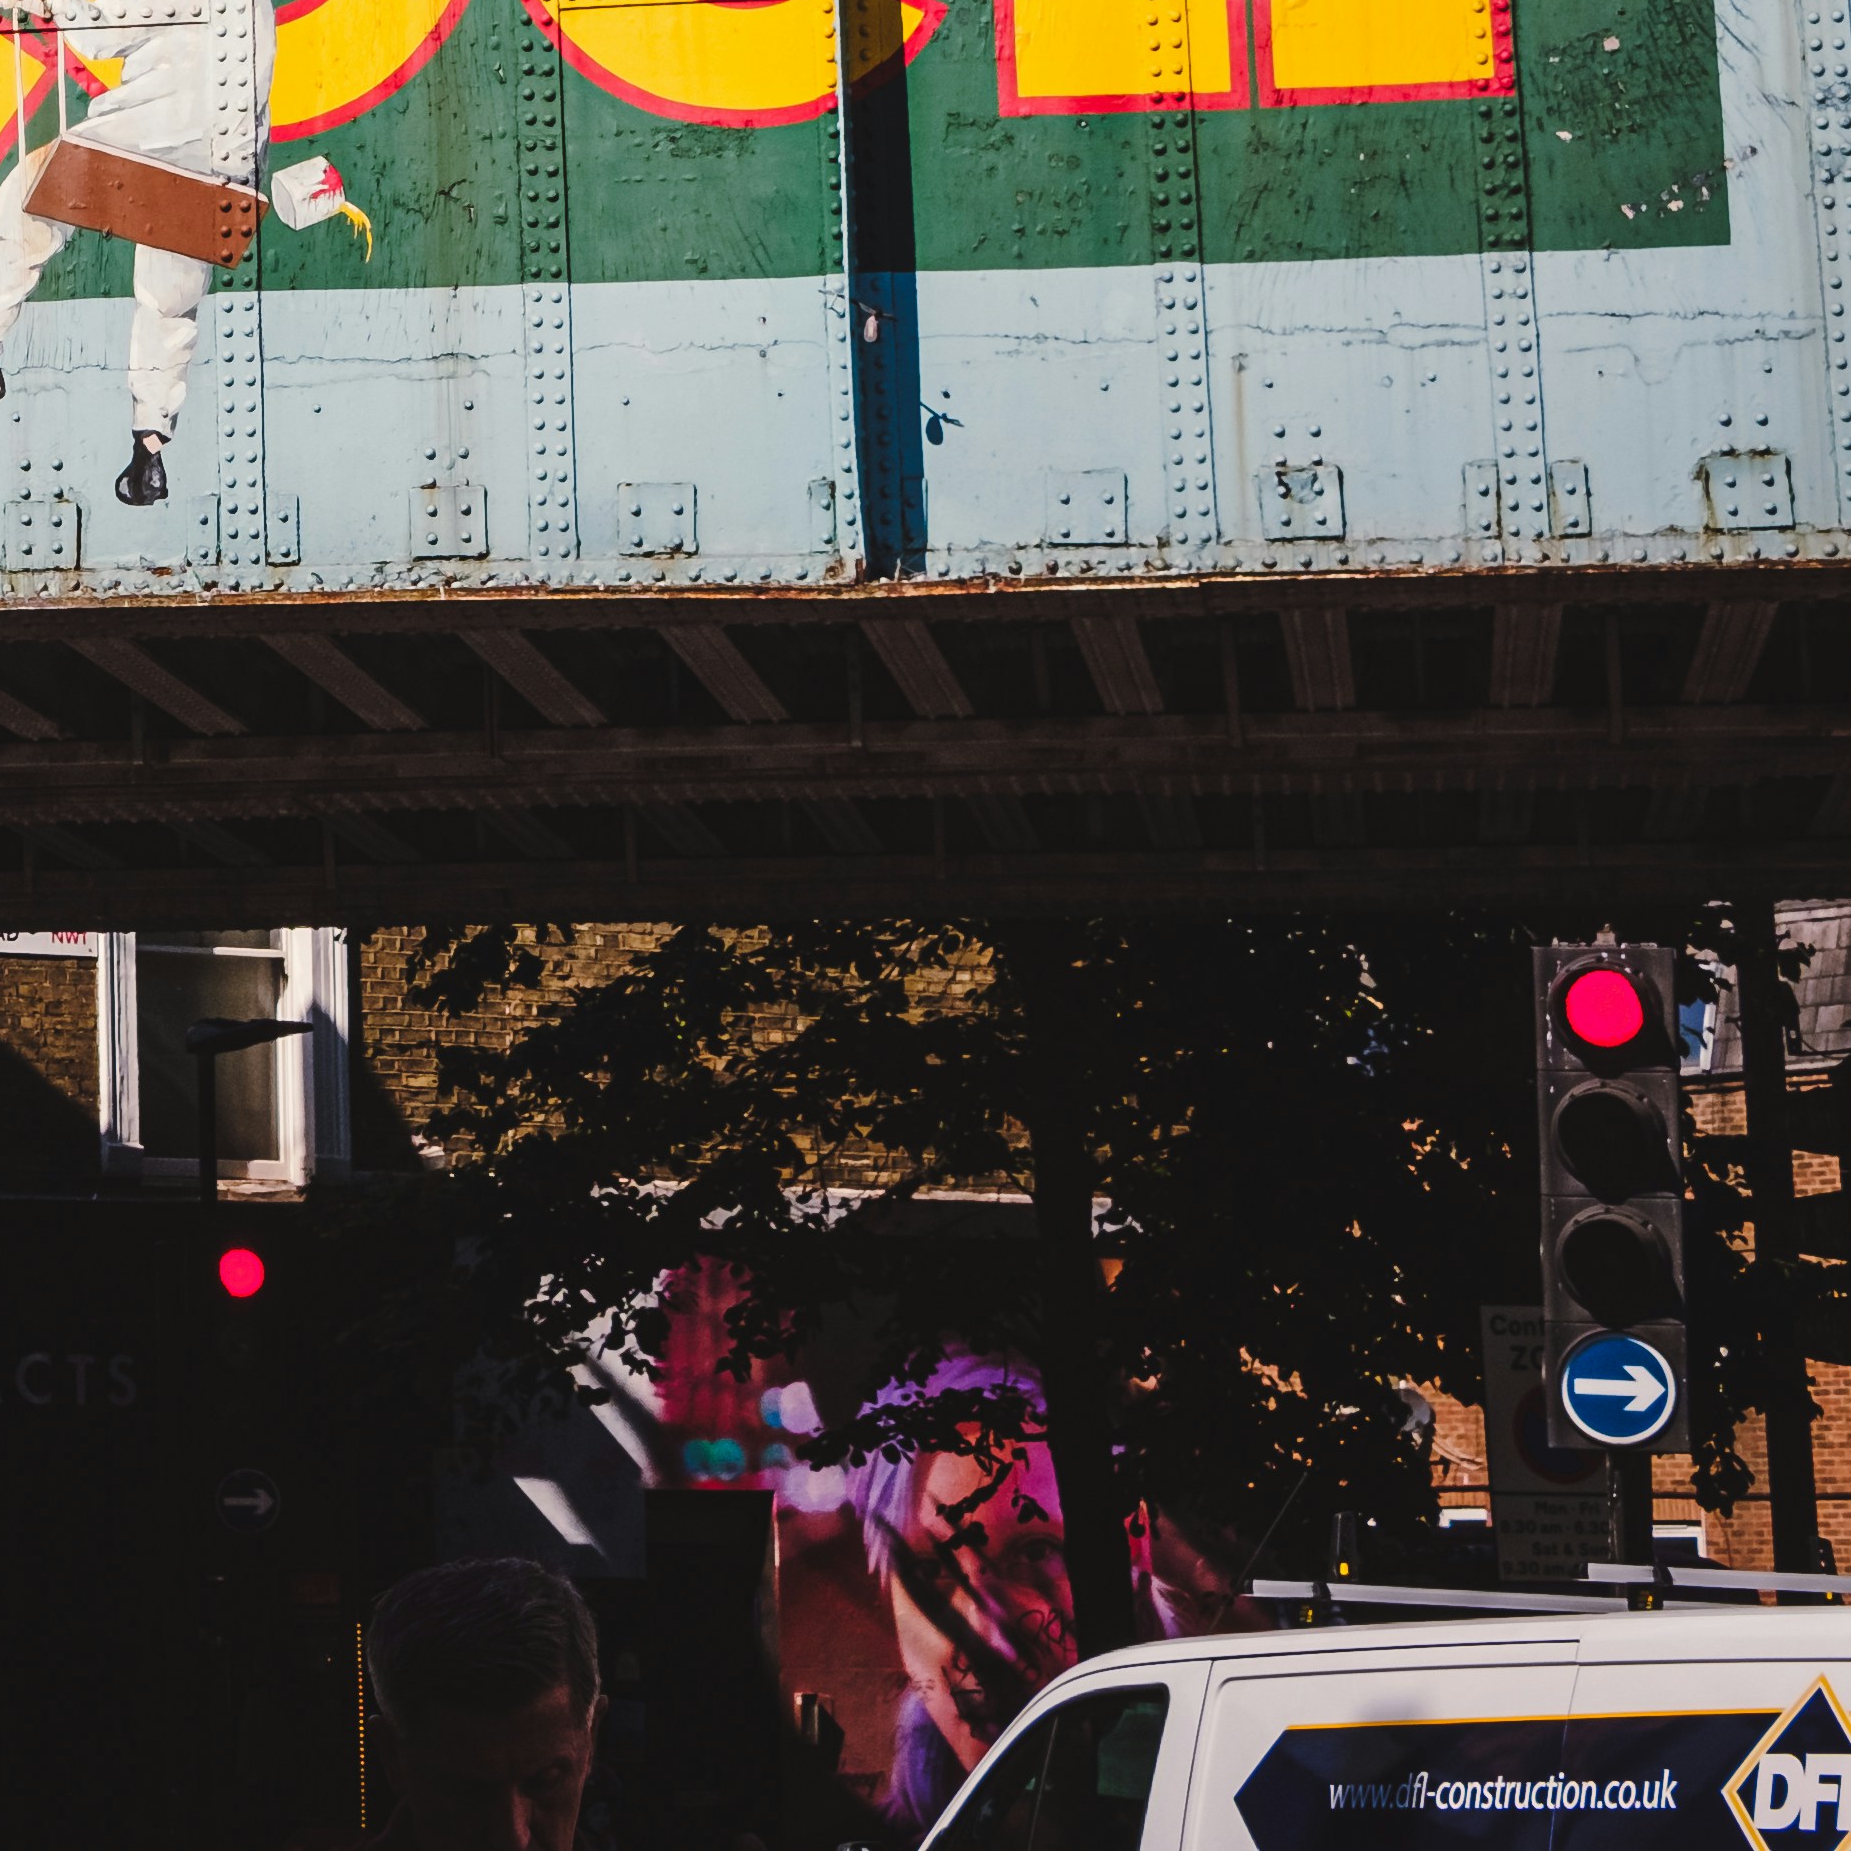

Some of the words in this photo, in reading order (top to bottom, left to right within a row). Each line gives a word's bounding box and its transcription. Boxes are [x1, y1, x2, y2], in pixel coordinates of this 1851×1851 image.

[1534, 1501, 1566, 1515] Mon
[1579, 1501, 1600, 1515] Fri
[1532, 1542, 1558, 1556] Sat
[1579, 1542, 1608, 1556] Sun
[1501, 1561, 1538, 1575] 9.30
[1328, 1767, 1679, 1812] www.dfl-construction.co.uk
